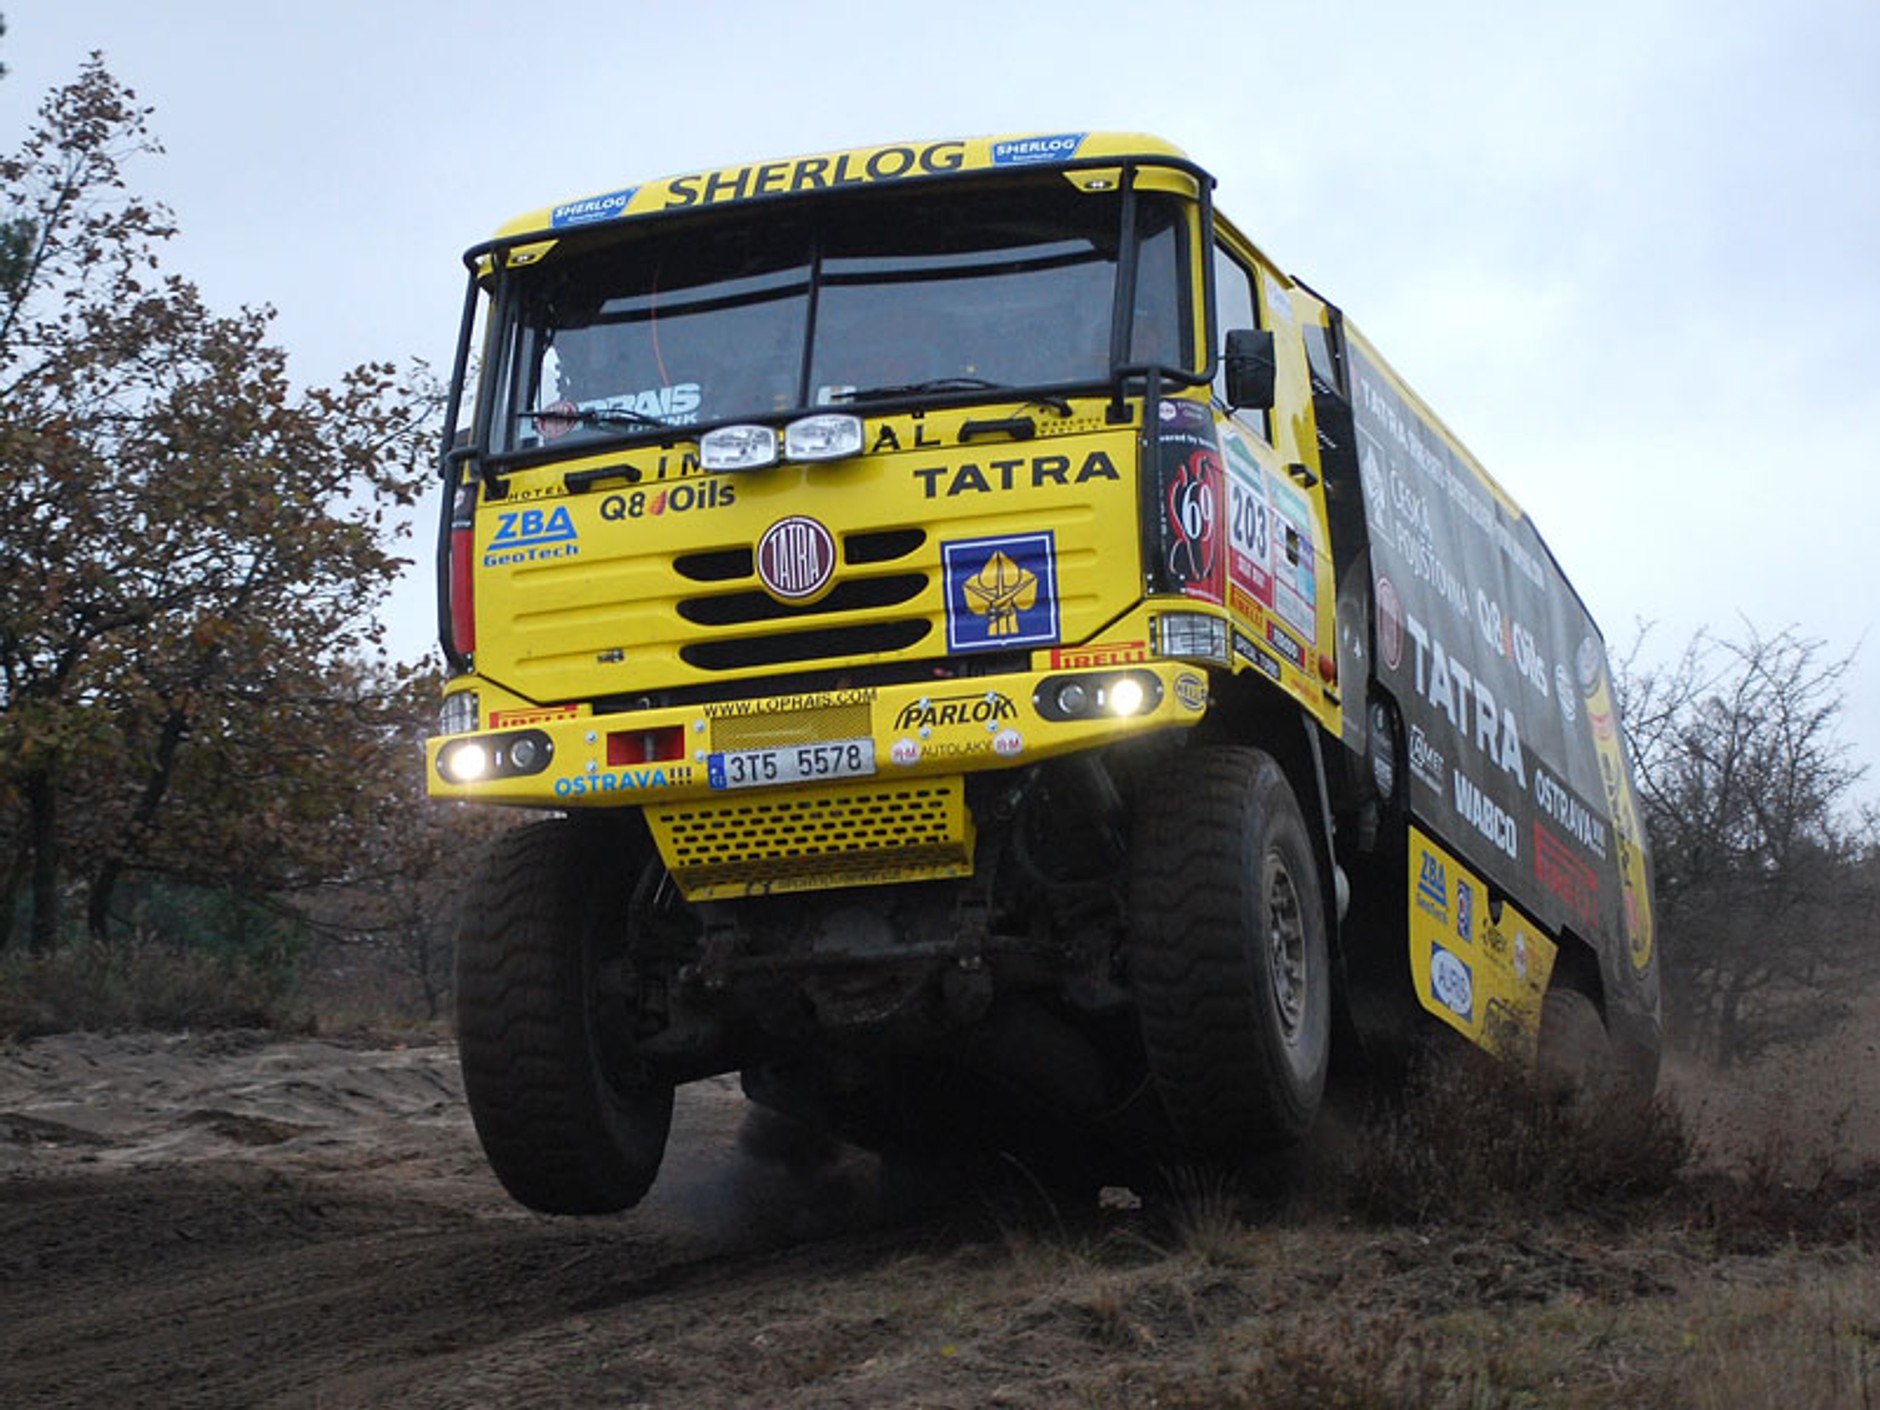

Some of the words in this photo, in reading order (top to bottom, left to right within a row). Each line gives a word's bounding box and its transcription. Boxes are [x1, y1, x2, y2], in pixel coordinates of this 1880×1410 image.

[995, 138, 1075, 157] SHERLOG
[664, 141, 966, 208] SHERLOG
[554, 195, 627, 218] SHERLOG
[913, 450, 1121, 499] TATRA
[599, 490, 646, 522] Q8
[668, 479, 736, 512] Oils
[1232, 484, 1267, 559] 203
[493, 506, 578, 540] ZBA
[769, 523, 820, 591] TATRA
[1050, 640, 1146, 672] PIRELLI
[902, 698, 1010, 730] PARLOK
[1406, 612, 1528, 791] TATRA
[730, 755, 778, 784] 3T5
[797, 743, 862, 777] 5578
[1453, 769, 1518, 860] WABCO
